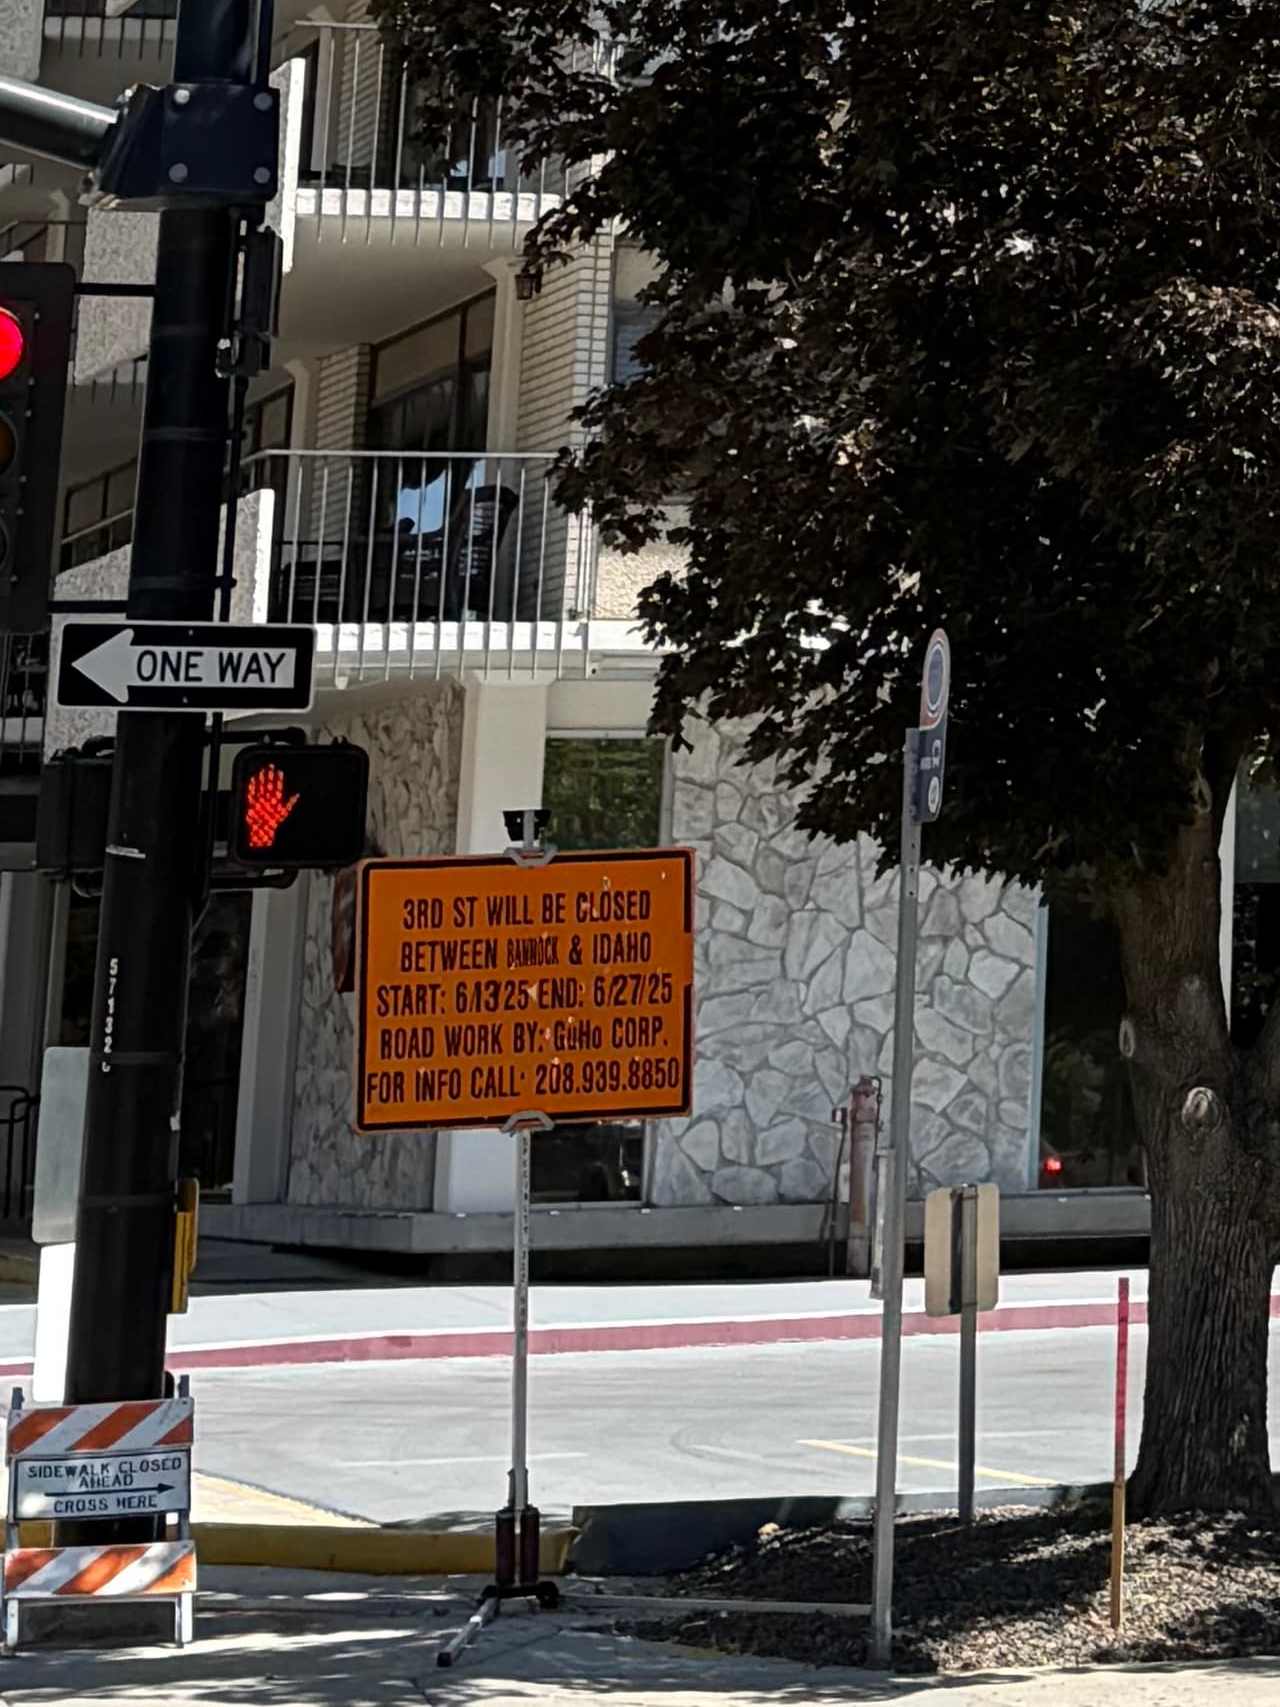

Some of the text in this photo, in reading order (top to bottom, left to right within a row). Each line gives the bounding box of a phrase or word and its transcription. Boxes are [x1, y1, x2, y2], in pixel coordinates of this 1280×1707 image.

[136, 649, 287, 684] ONE WAY
[402, 890, 651, 930] 3RD ST WILL BE CLOSED
[400, 931, 652, 973] BETWEEN BANNOCK & IDAHO
[376, 983, 446, 1017] START:
[537, 977, 585, 1010] END:
[593, 972, 673, 1008] 6/27/25
[380, 1026, 435, 1060] ROAD
[444, 1023, 505, 1058] WORK
[513, 1021, 545, 1055] BY:
[611, 1015, 669, 1050] CORP.
[367, 1071, 405, 1105] FOR
[415, 1067, 462, 1102] INFO
[534, 1056, 681, 1096] 208.939.8850
[27, 1457, 183, 1480] SIDEWALK CLOSED
[79, 1473, 134, 1490] AHEAD
[53, 1494, 159, 1514] CROSS HERE
